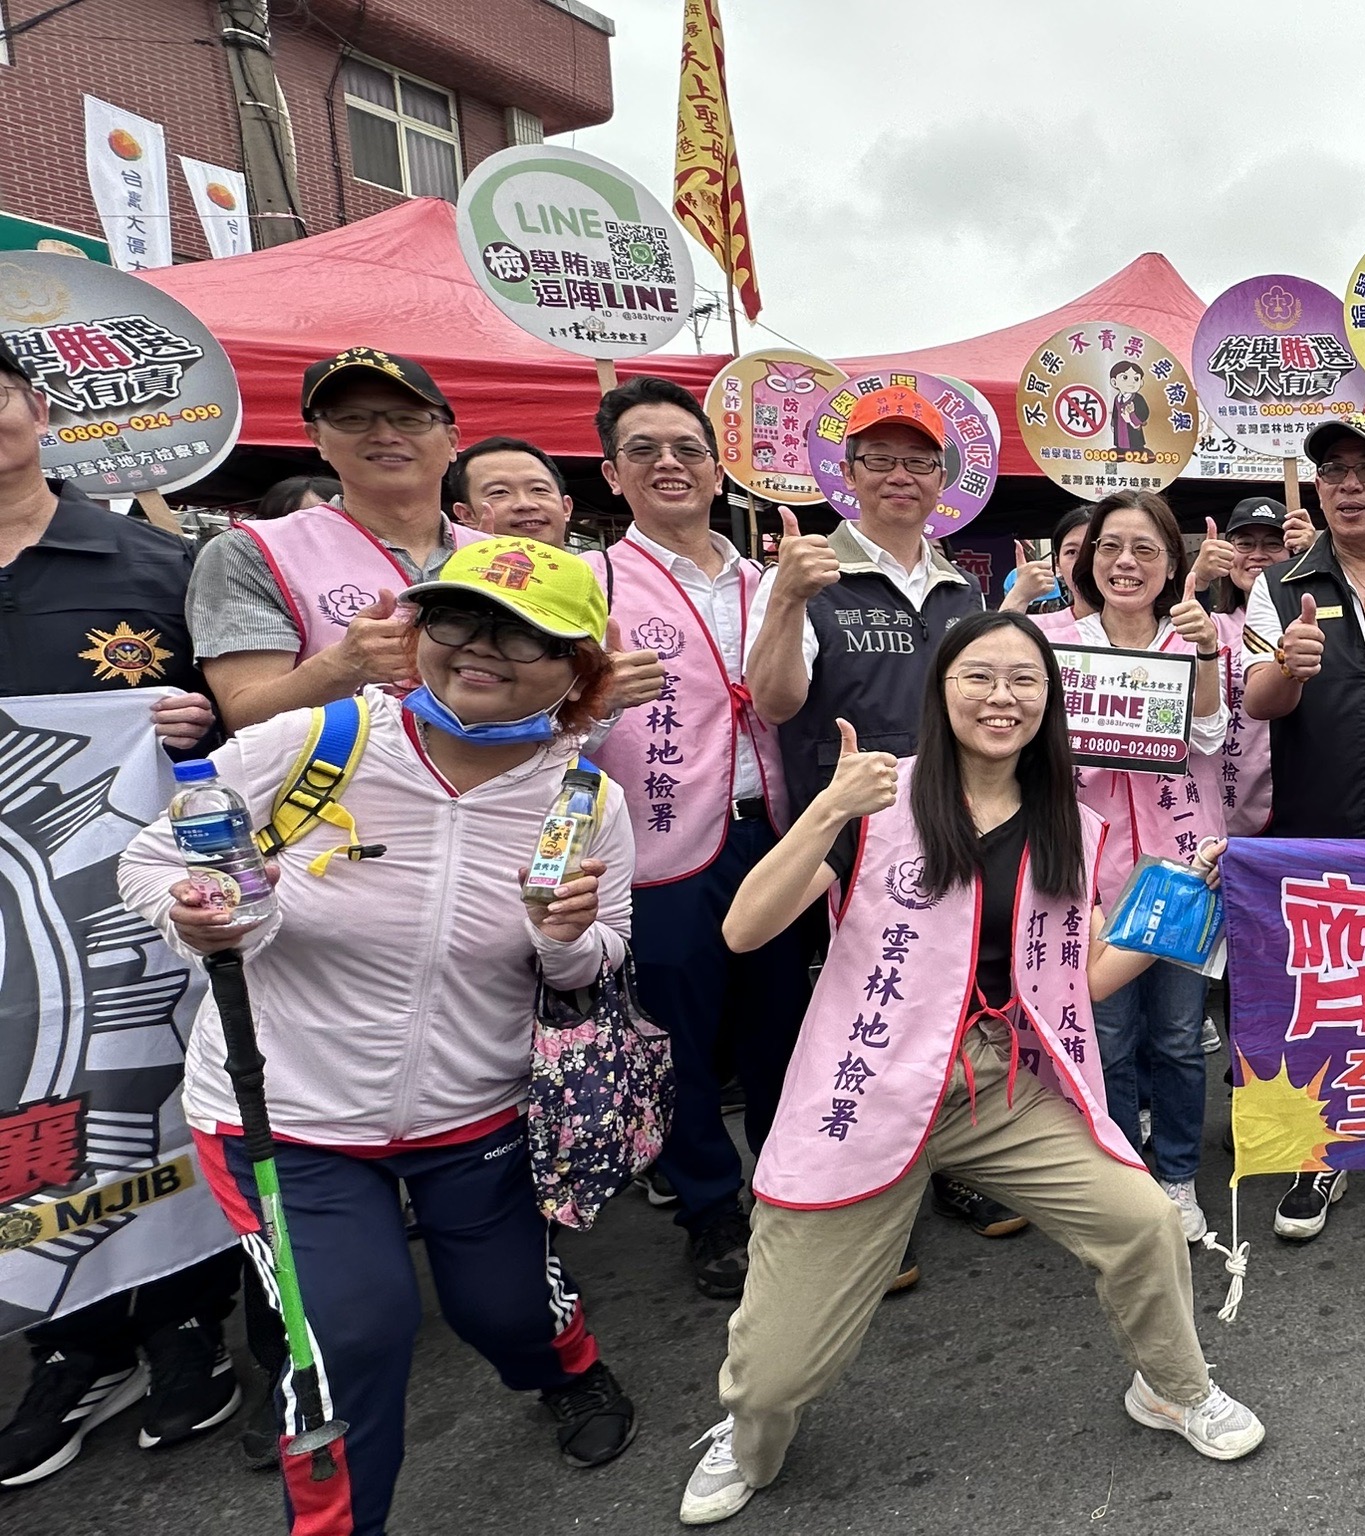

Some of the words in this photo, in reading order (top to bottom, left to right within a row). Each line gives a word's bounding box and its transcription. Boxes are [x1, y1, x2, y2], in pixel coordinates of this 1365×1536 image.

[680, 42, 726, 170] 天上聖母
[515, 202, 603, 239] LINE
[483, 246, 612, 281] 檢舉賄選
[531, 278, 679, 313] 逗陣LINE
[1068, 328, 1145, 358] 不賣票
[1209, 335, 1355, 371] 檢舉賄選
[1024, 350, 1066, 427] 不買票
[1226, 371, 1339, 397] 人人有責
[59, 403, 222, 444] 0800-024-099
[1218, 405, 1258, 417] 檢舉電話
[1260, 401, 1354, 416] 0800-024-099
[933, 389, 993, 499] 杜絕收賄
[1236, 423, 1324, 435] 臺灣雲林地方檢
[1041, 447, 1082, 460] 檢舉電話
[1084, 448, 1180, 464] 0800-024-099
[1061, 473, 1162, 488] 臺灣雲林地方檢察署
[835, 607, 913, 628] 調查局
[843, 629, 916, 655] MJIB
[644, 671, 684, 833] 雲林地檢署
[1067, 736, 1177, 759] 線:0800-024099
[817, 922, 920, 1142] 雲林地檢署
[484, 1135, 524, 1162] adidas
[55, 1164, 182, 1232] MJIB
